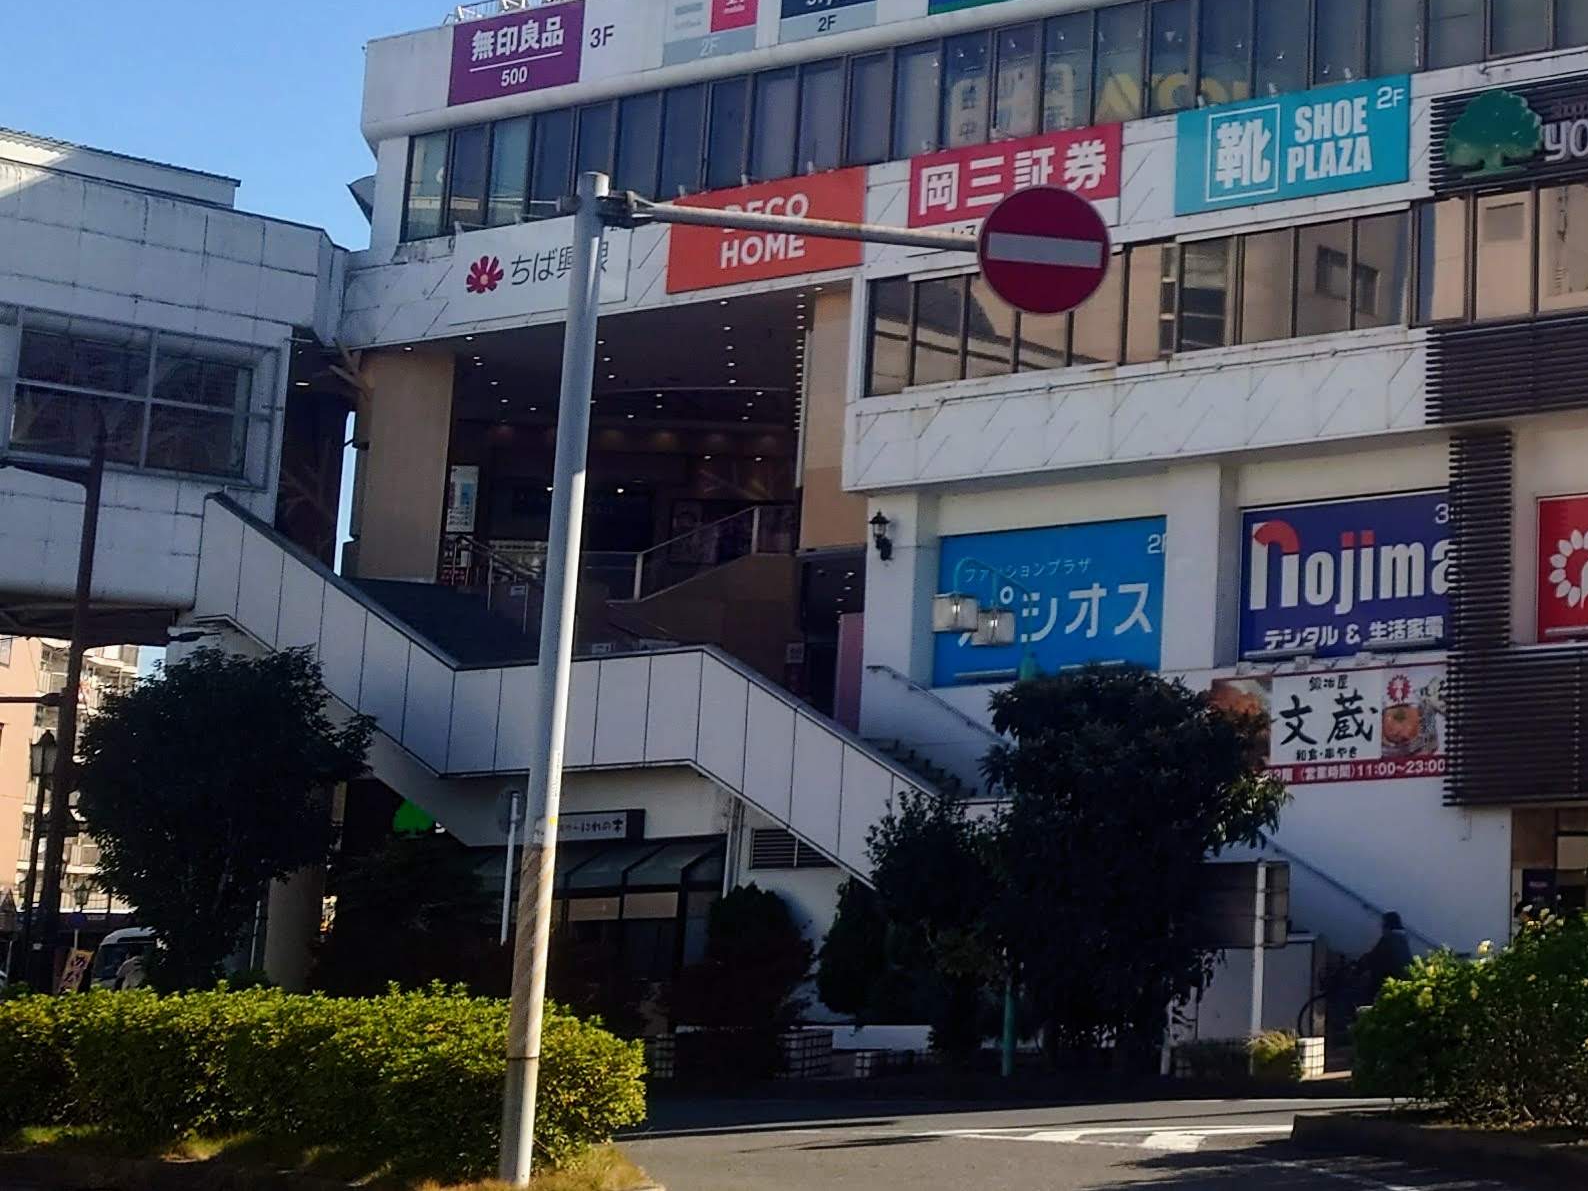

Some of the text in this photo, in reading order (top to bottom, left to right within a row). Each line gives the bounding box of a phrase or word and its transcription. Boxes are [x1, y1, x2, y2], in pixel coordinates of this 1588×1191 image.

[471, 15, 564, 62] 無印良品
[590, 24, 615, 49] 3F
[817, 14, 837, 33] 2F
[701, 37, 721, 57] 2F
[500, 65, 528, 87] 500
[1376, 86, 1405, 110] 2F
[1294, 96, 1369, 144] SHOE
[1215, 118, 1272, 190] 靴
[1286, 135, 1373, 184] PLAZA
[919, 138, 1108, 216] 岡三証券
[720, 232, 806, 270] HOME
[964, 557, 1092, 583] ファションプラザ
[1345, 623, 1361, 645] &
[1278, 688, 1379, 746] 文蔵
